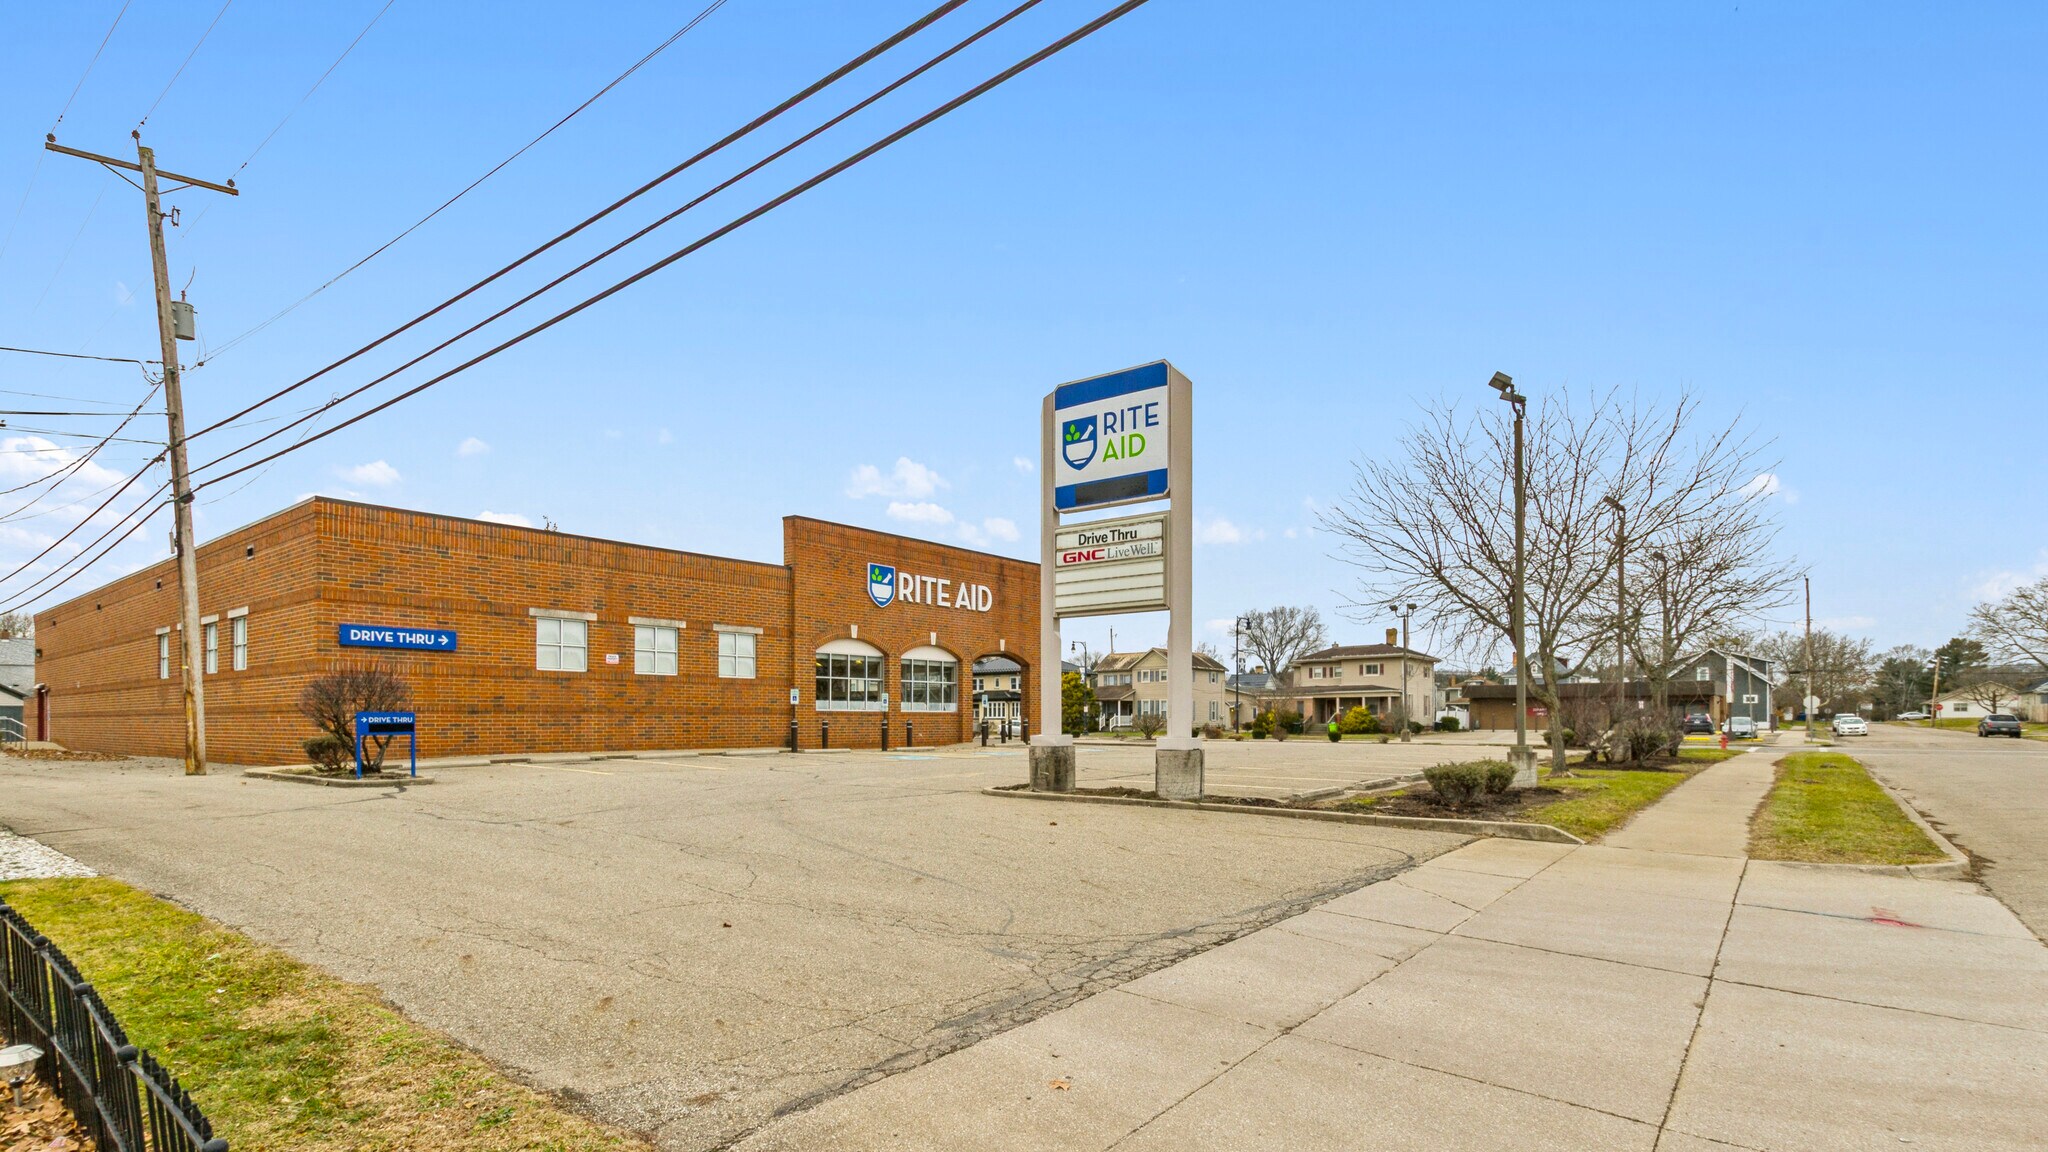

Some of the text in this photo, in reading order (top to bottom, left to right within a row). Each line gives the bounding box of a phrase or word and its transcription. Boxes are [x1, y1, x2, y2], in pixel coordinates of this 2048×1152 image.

[1103, 401, 1159, 436] RITE
[1102, 432, 1146, 462] AID
[1078, 529, 1138, 546] Drive Thru
[1063, 548, 1105, 564] GNC
[898, 572, 993, 612] RITE AID
[350, 629, 435, 645] DRIVE THRU
